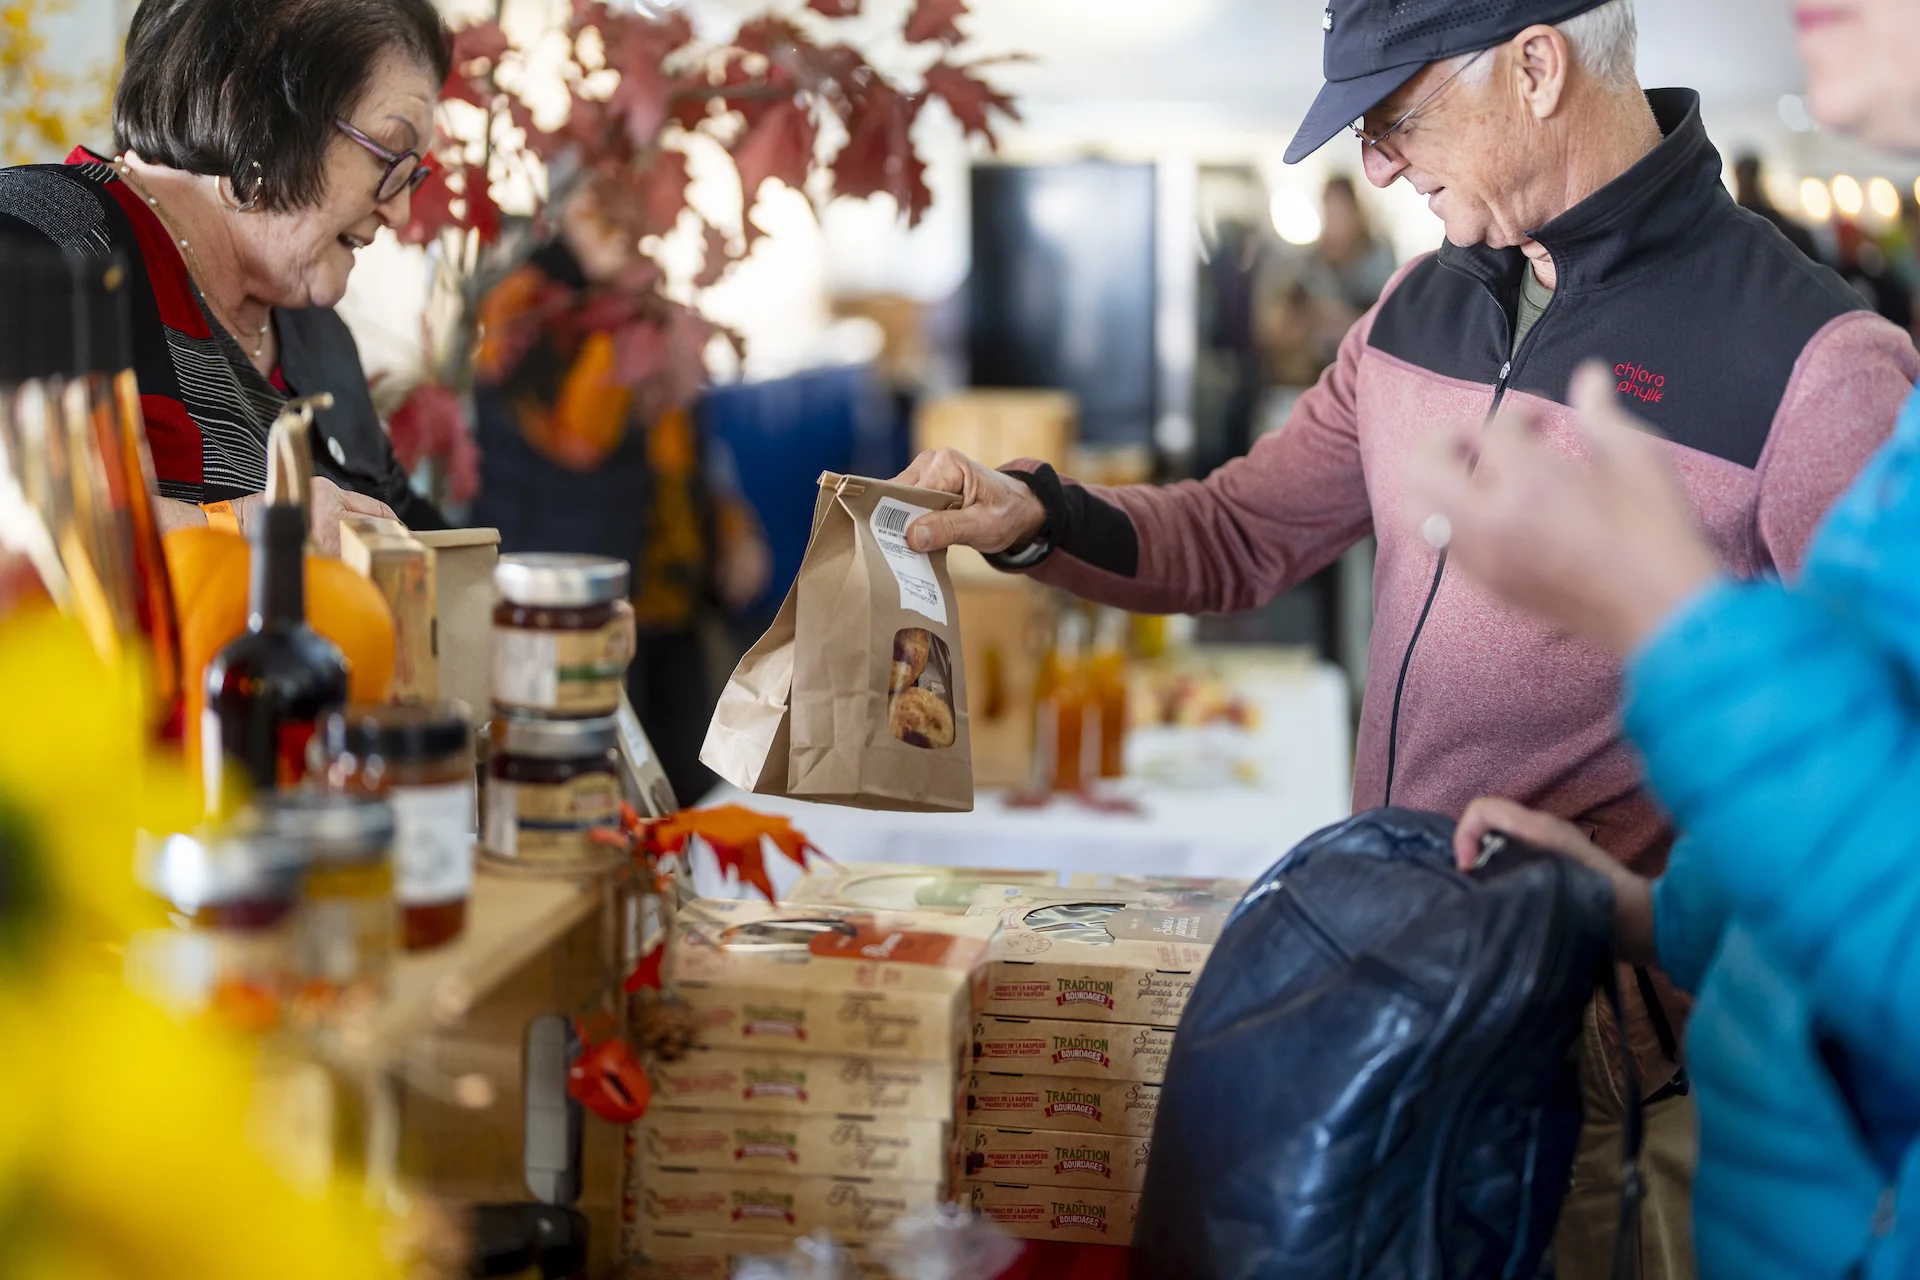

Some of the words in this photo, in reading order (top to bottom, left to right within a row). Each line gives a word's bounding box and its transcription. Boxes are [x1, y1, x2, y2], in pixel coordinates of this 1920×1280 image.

[1613, 361, 1665, 387] chloro
[1615, 380, 1664, 402] phylle
[1057, 978, 1113, 995] TRADITION
[1138, 972, 1173, 987] Sucre
[1065, 991, 1106, 1003] BOURDAGES
[1053, 1036, 1109, 1053] TRADITION
[1133, 1030, 1168, 1045] Sucre
[1061, 1050, 1101, 1061] BOURDAGES
[1045, 1090, 1101, 1106] TRADITION
[1054, 1102, 1094, 1115] BOURDAGES
[1055, 1147, 1110, 1164] TRADITION
[1063, 1160, 1104, 1172] BOURDAGES
[1051, 1202, 1106, 1219] TRADITION
[1059, 1215, 1100, 1227] BOURDAGES
